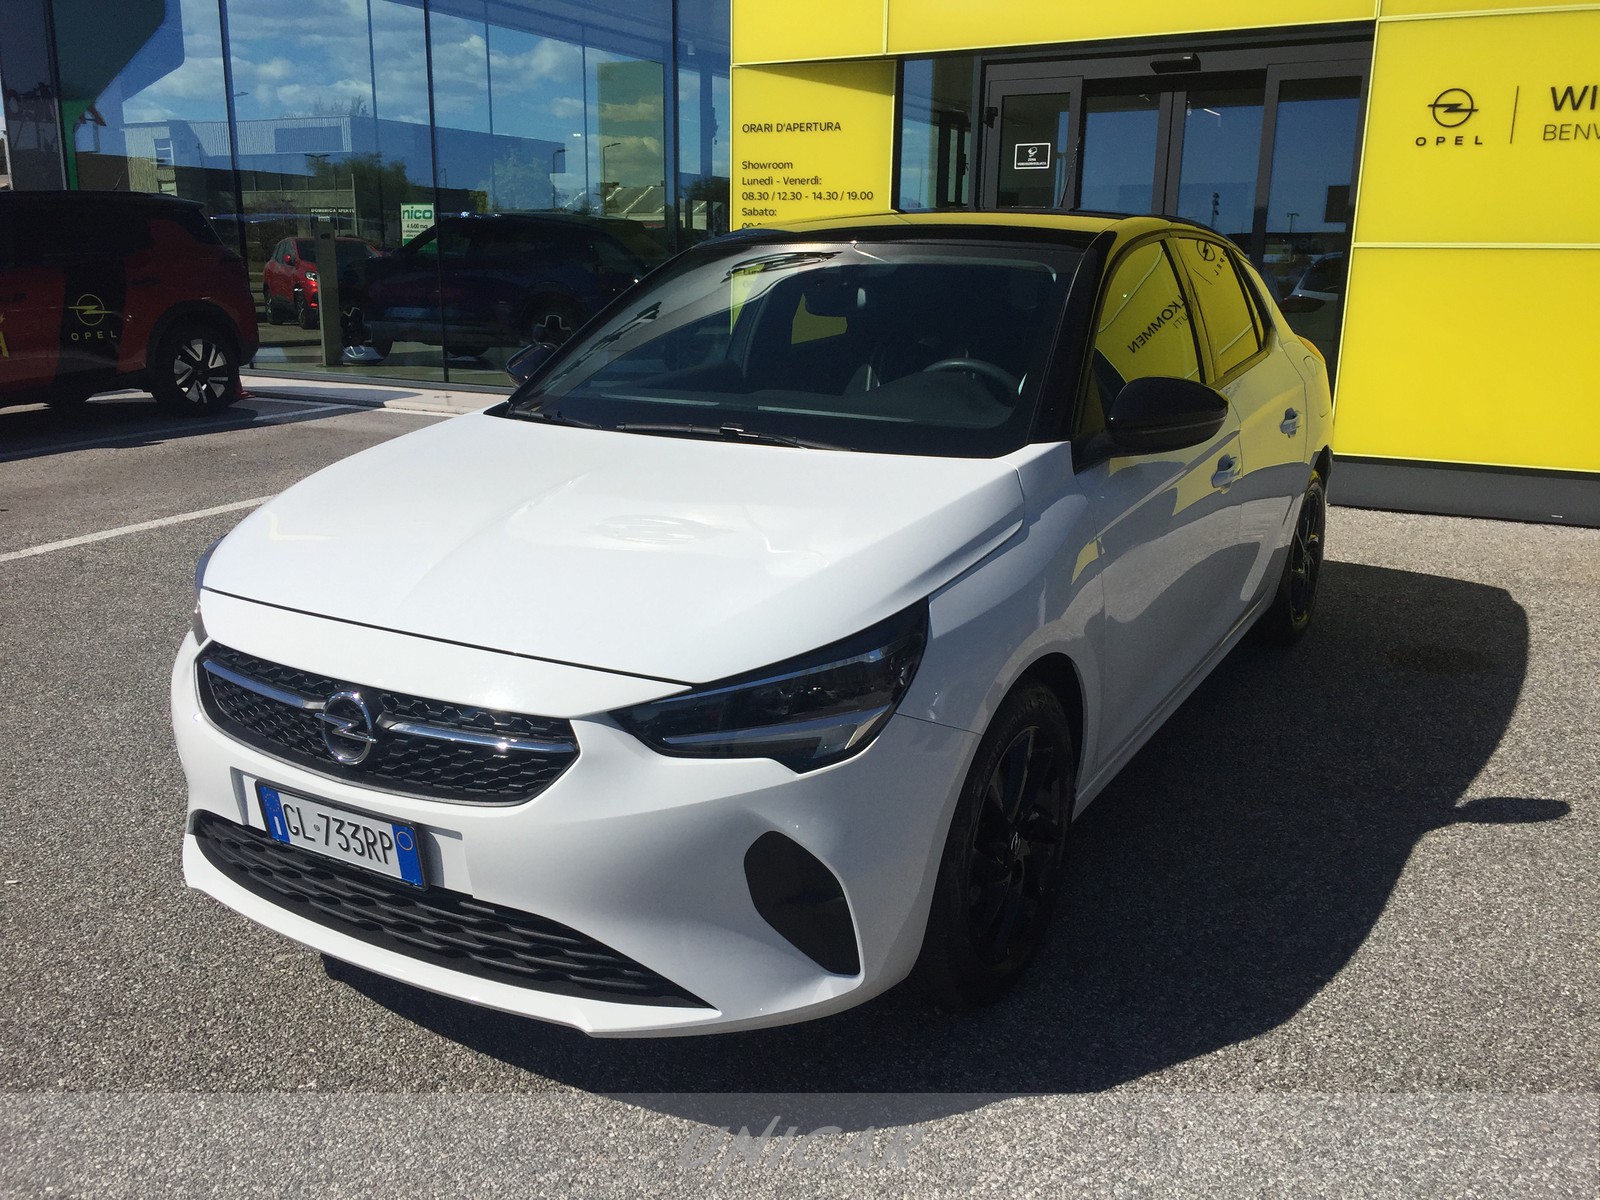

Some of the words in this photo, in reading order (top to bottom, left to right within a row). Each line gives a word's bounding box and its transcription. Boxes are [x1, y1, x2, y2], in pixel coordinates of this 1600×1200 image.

[742, 123, 773, 134] ORARI
[776, 121, 842, 133] D'APERTURA
[1415, 135, 1483, 147] OPEL
[741, 160, 793, 170] Showroom
[741, 176, 773, 186] Lunedì
[783, 176, 822, 185] Venerdì:
[741, 191, 769, 201] 08.30
[778, 191, 802, 201] 12.30
[812, 191, 838, 201] 14.30
[846, 190, 874, 201] 19.00
[402, 206, 433, 219] nico
[741, 207, 777, 217] Sabato:
[71, 330, 117, 341] OPEL
